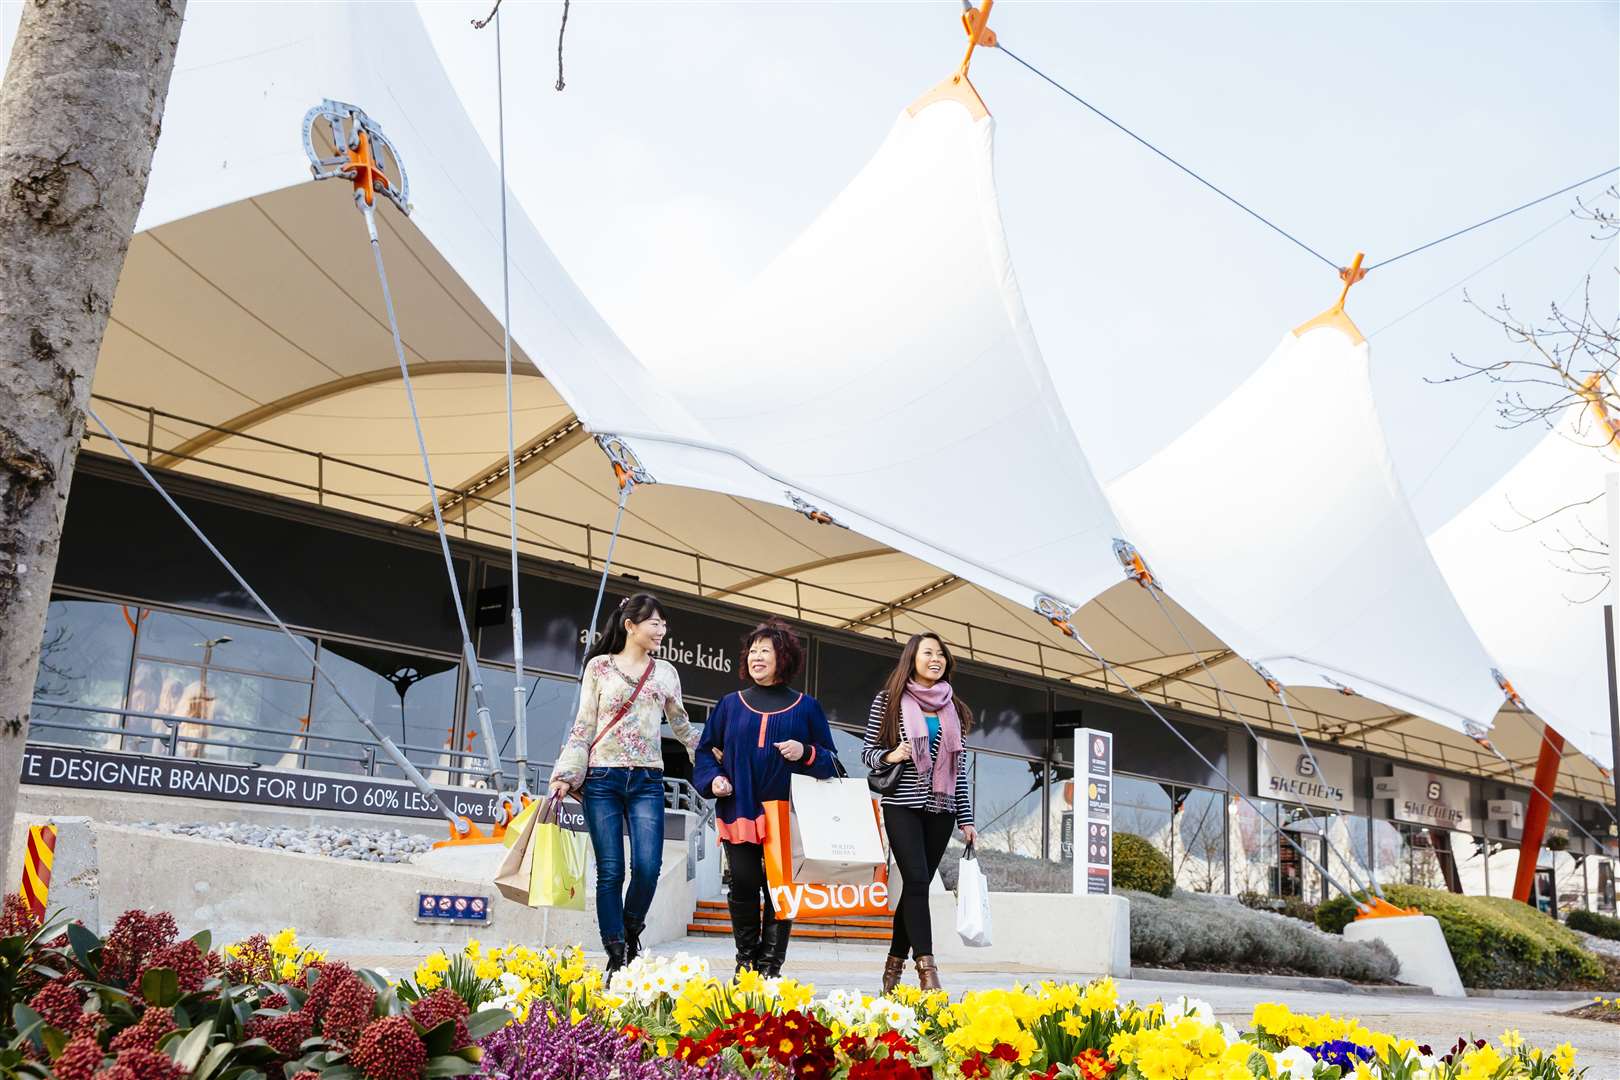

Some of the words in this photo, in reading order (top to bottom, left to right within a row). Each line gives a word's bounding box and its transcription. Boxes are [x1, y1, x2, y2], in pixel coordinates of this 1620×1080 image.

[696, 644, 732, 673] kids
[49, 757, 162, 788] DESIGNER
[169, 769, 250, 796] BRANDS
[256, 777, 297, 799] FOR
[303, 782, 326, 801] UP
[332, 784, 358, 805] TO
[363, 788, 399, 809] 60%
[454, 795, 483, 817] love
